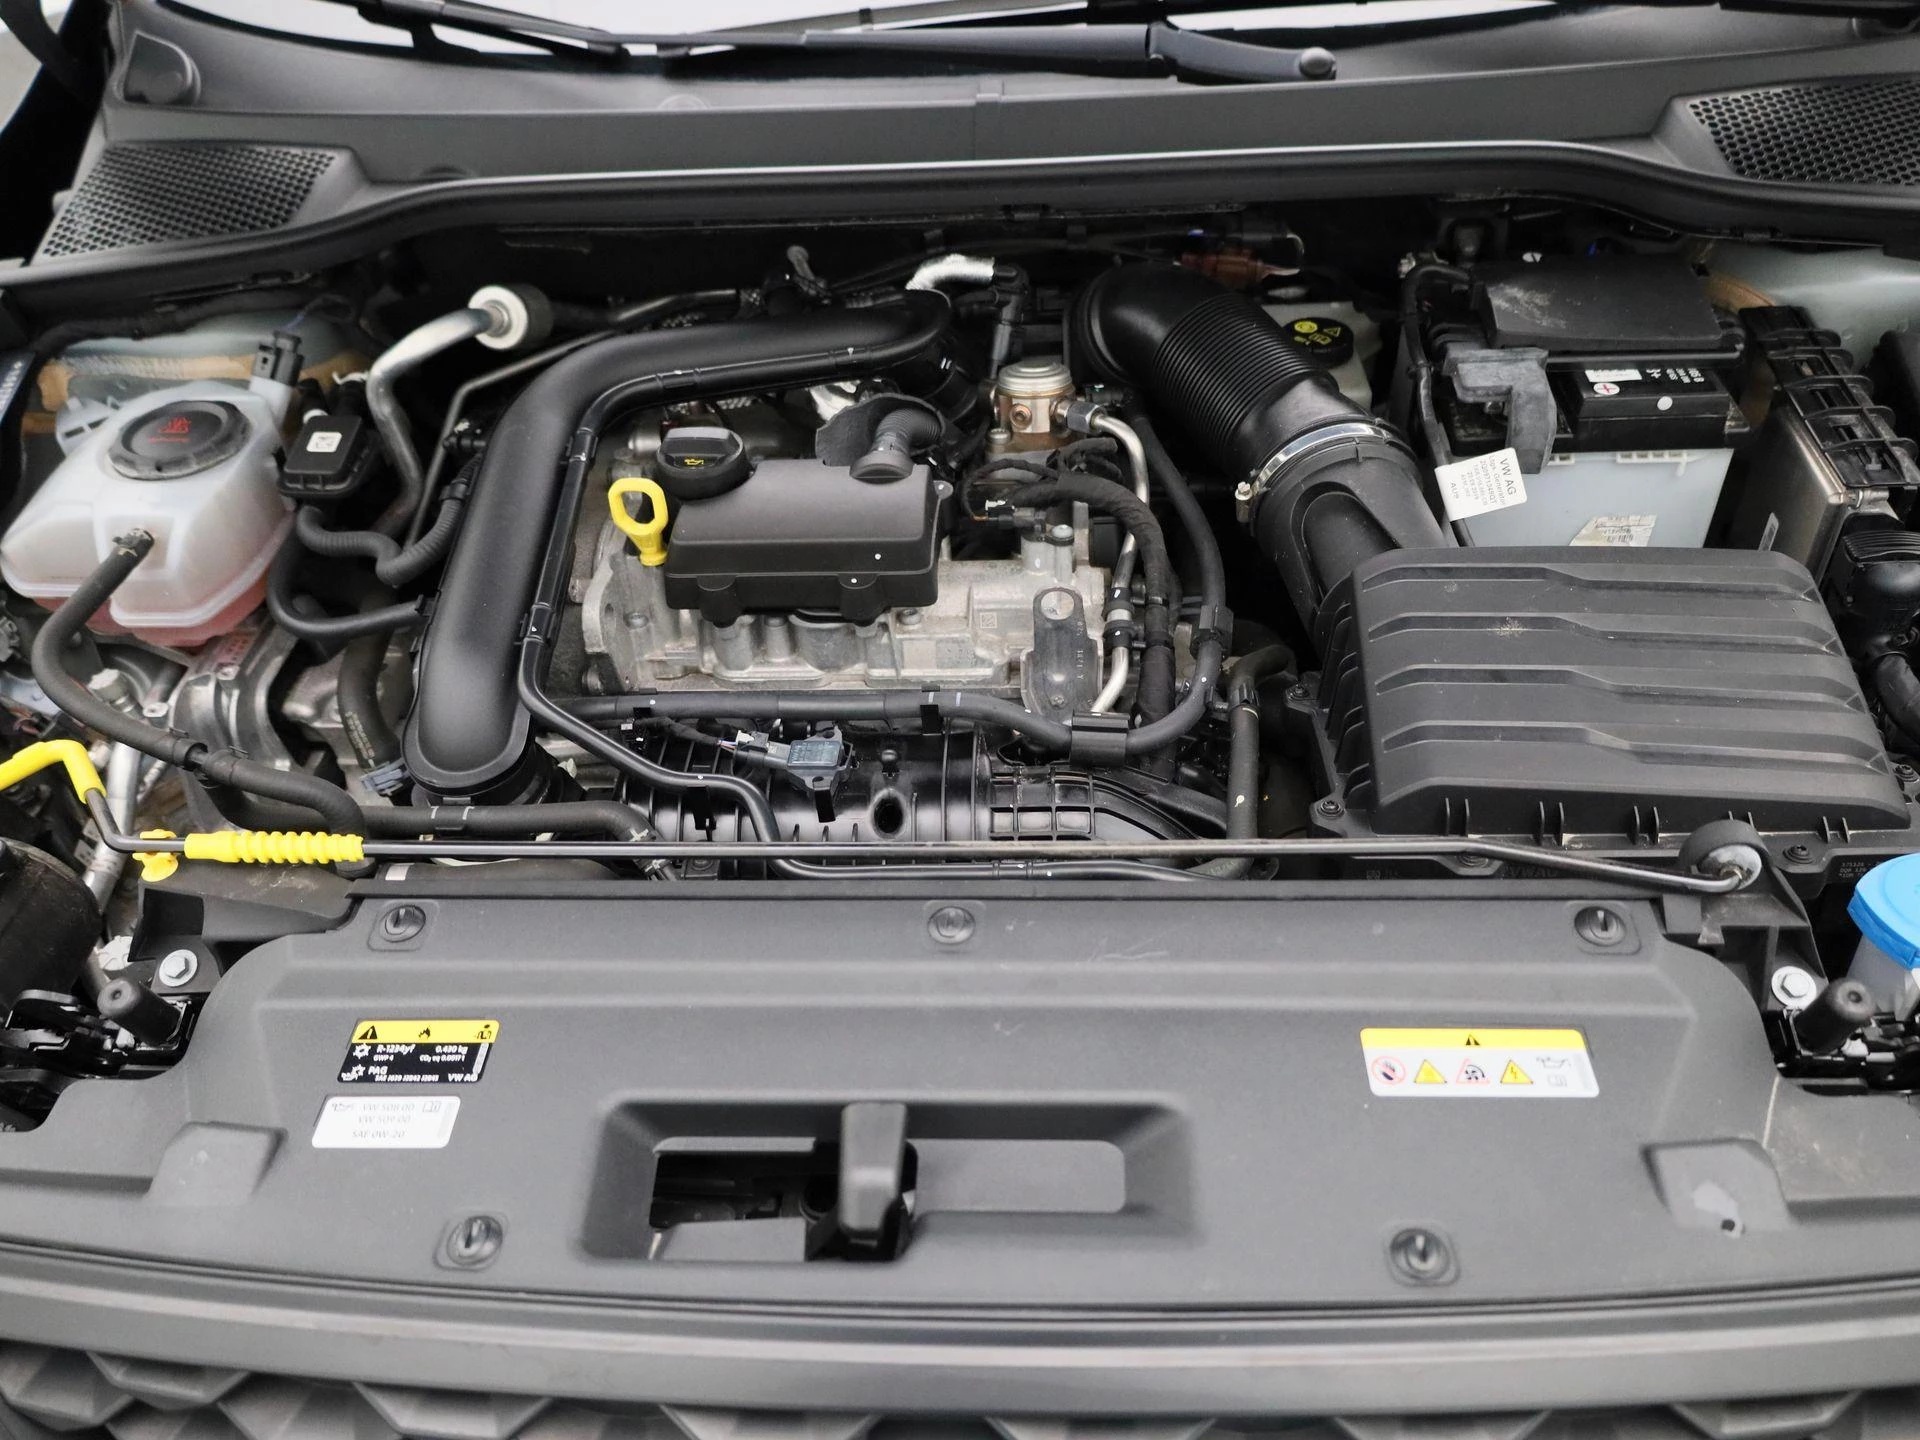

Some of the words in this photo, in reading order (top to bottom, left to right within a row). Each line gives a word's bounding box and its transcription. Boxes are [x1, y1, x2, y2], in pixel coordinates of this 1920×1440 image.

[1500, 458, 1512, 476] VW
[1505, 479, 1517, 496] AG
[376, 1044, 416, 1055] R-1234yf
[368, 1066, 388, 1075] PAG
[447, 1073, 464, 1082] VW
